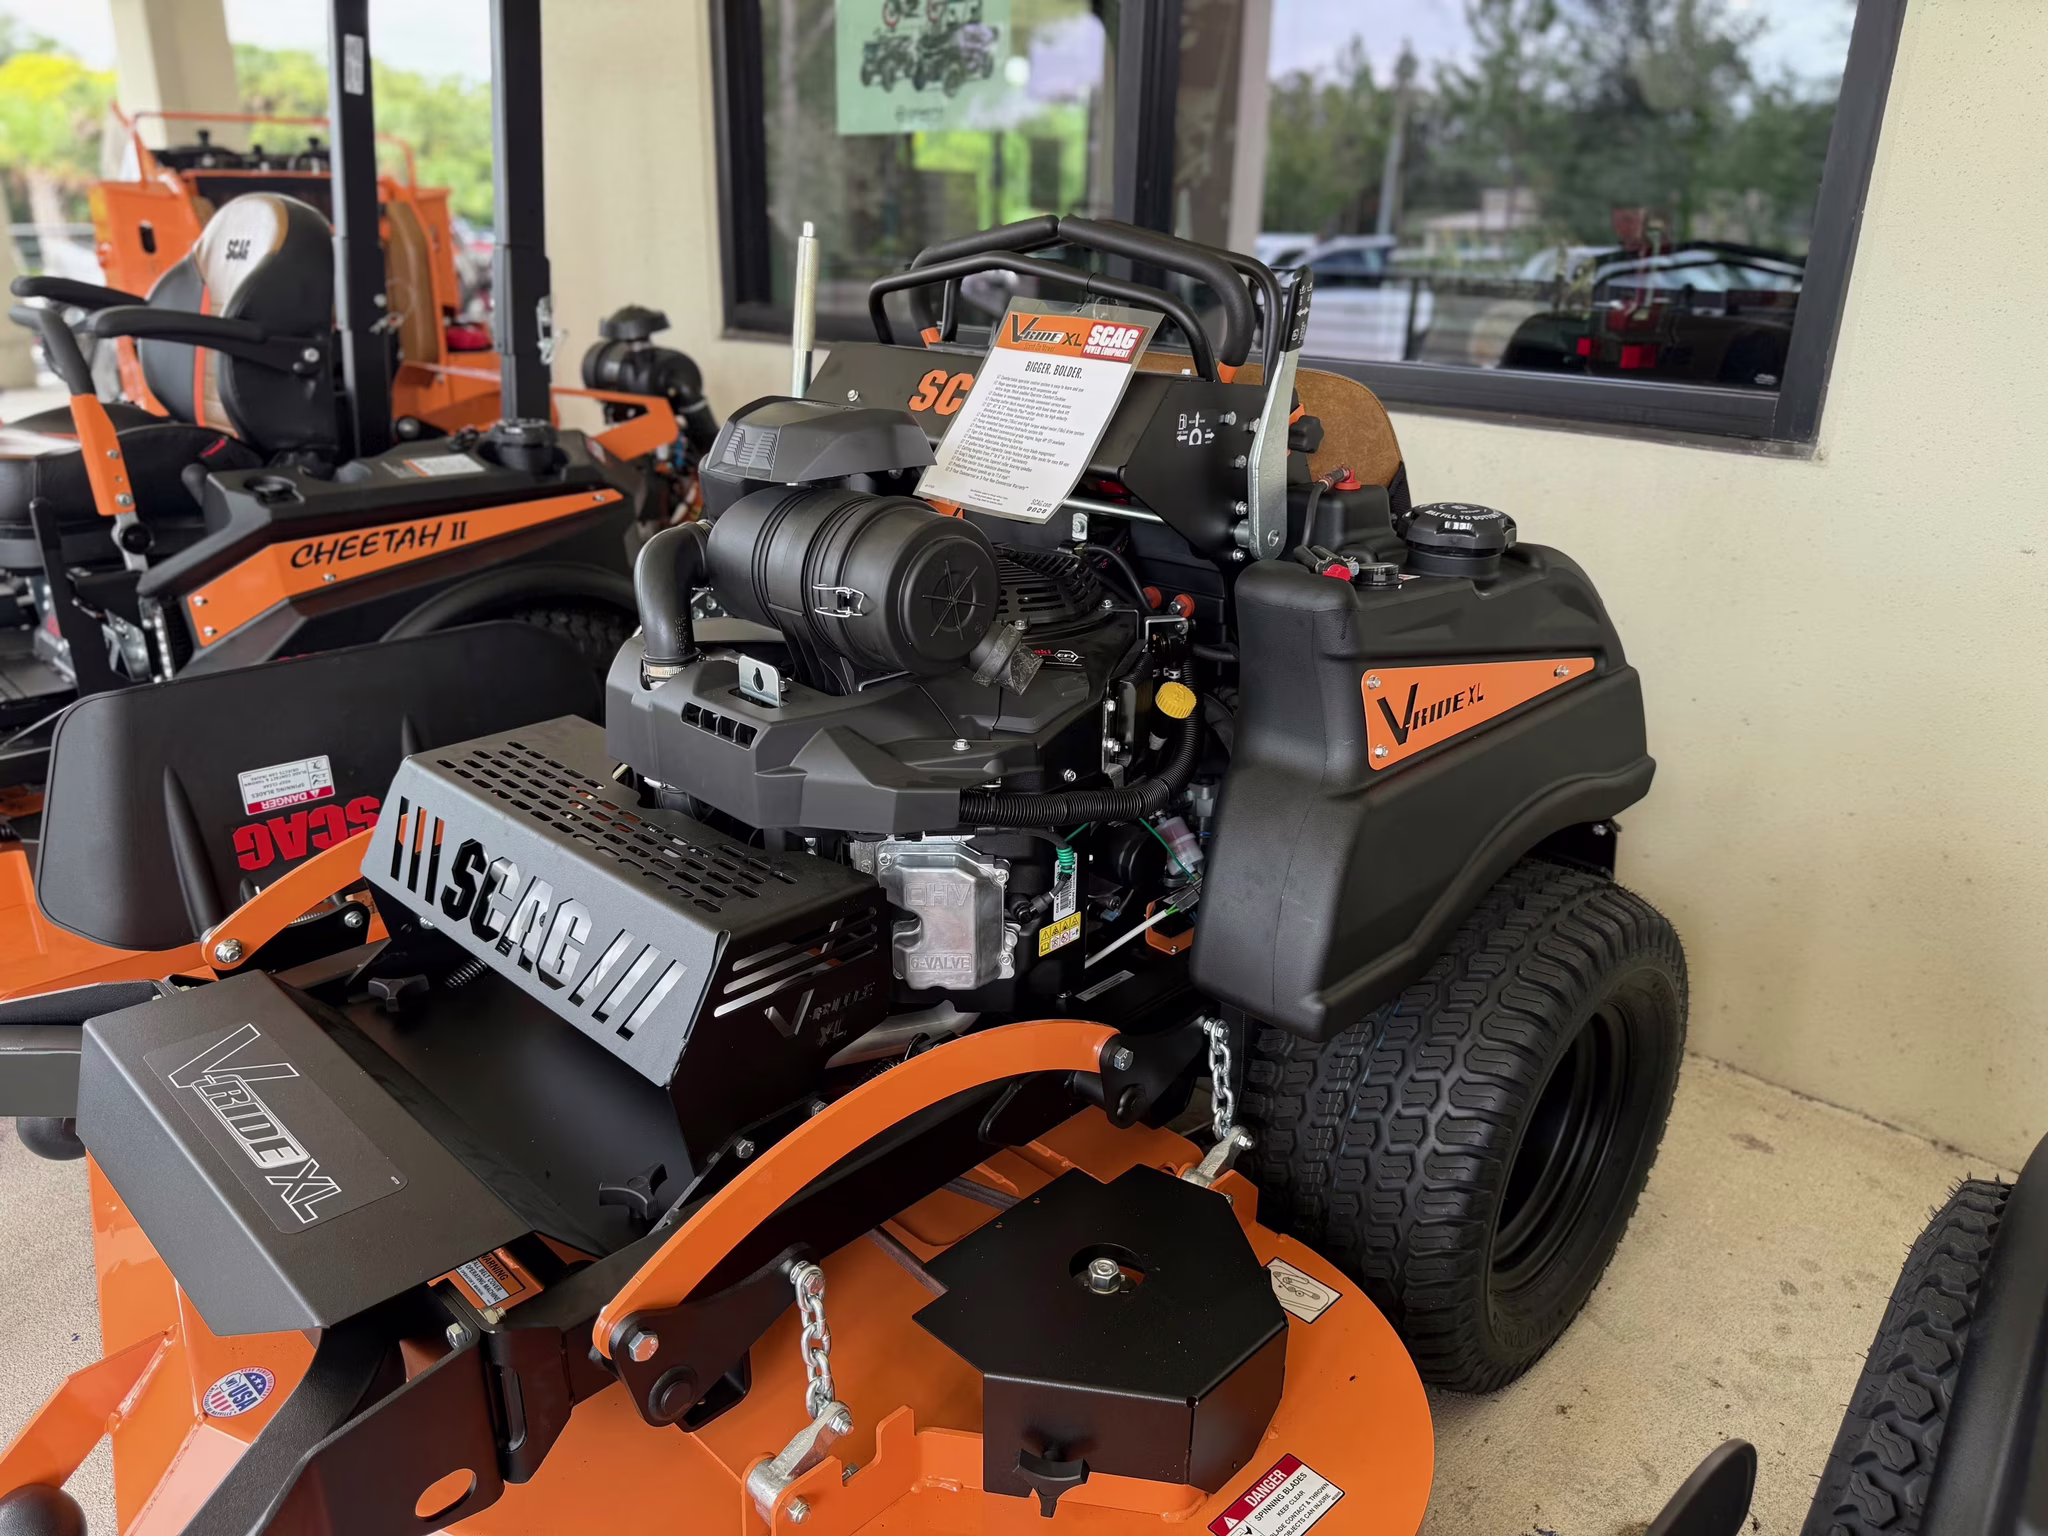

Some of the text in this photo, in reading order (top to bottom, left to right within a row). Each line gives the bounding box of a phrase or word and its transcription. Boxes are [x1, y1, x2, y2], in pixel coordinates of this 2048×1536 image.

[1062, 333, 1083, 347] XL
[1083, 345, 1101, 355] POWER
[1087, 324, 1139, 350] SCAG
[1025, 361, 1083, 379] BIGGER. BOLDER.
[1440, 511, 1457, 520] FILL
[291, 521, 467, 568] CHEETAH II
[1467, 682, 1484, 707] XL
[251, 782, 305, 798] SPINNING BLADES
[260, 791, 308, 809] DANGER
[232, 795, 381, 871] SCAG
[904, 882, 972, 906] OHV
[440, 838, 593, 991] SCAG
[910, 955, 971, 970] 6-VALVE
[264, 1158, 342, 1224] XL
[465, 1264, 501, 1302] OPERATING MACHINE
[487, 1277, 502, 1292] COVER
[227, 1383, 258, 1412] USA
[1244, 1469, 1288, 1507] DANGER
[1254, 1472, 1307, 1522] SPINNING BLADES
[1276, 1490, 1306, 1517] KEEP CLEAR
[1285, 1504, 1308, 1526] CONTACT
[1309, 1482, 1330, 1501] THROWN
[1303, 1507, 1316, 1520] CAN
[1313, 1493, 1331, 1510] INJURE
